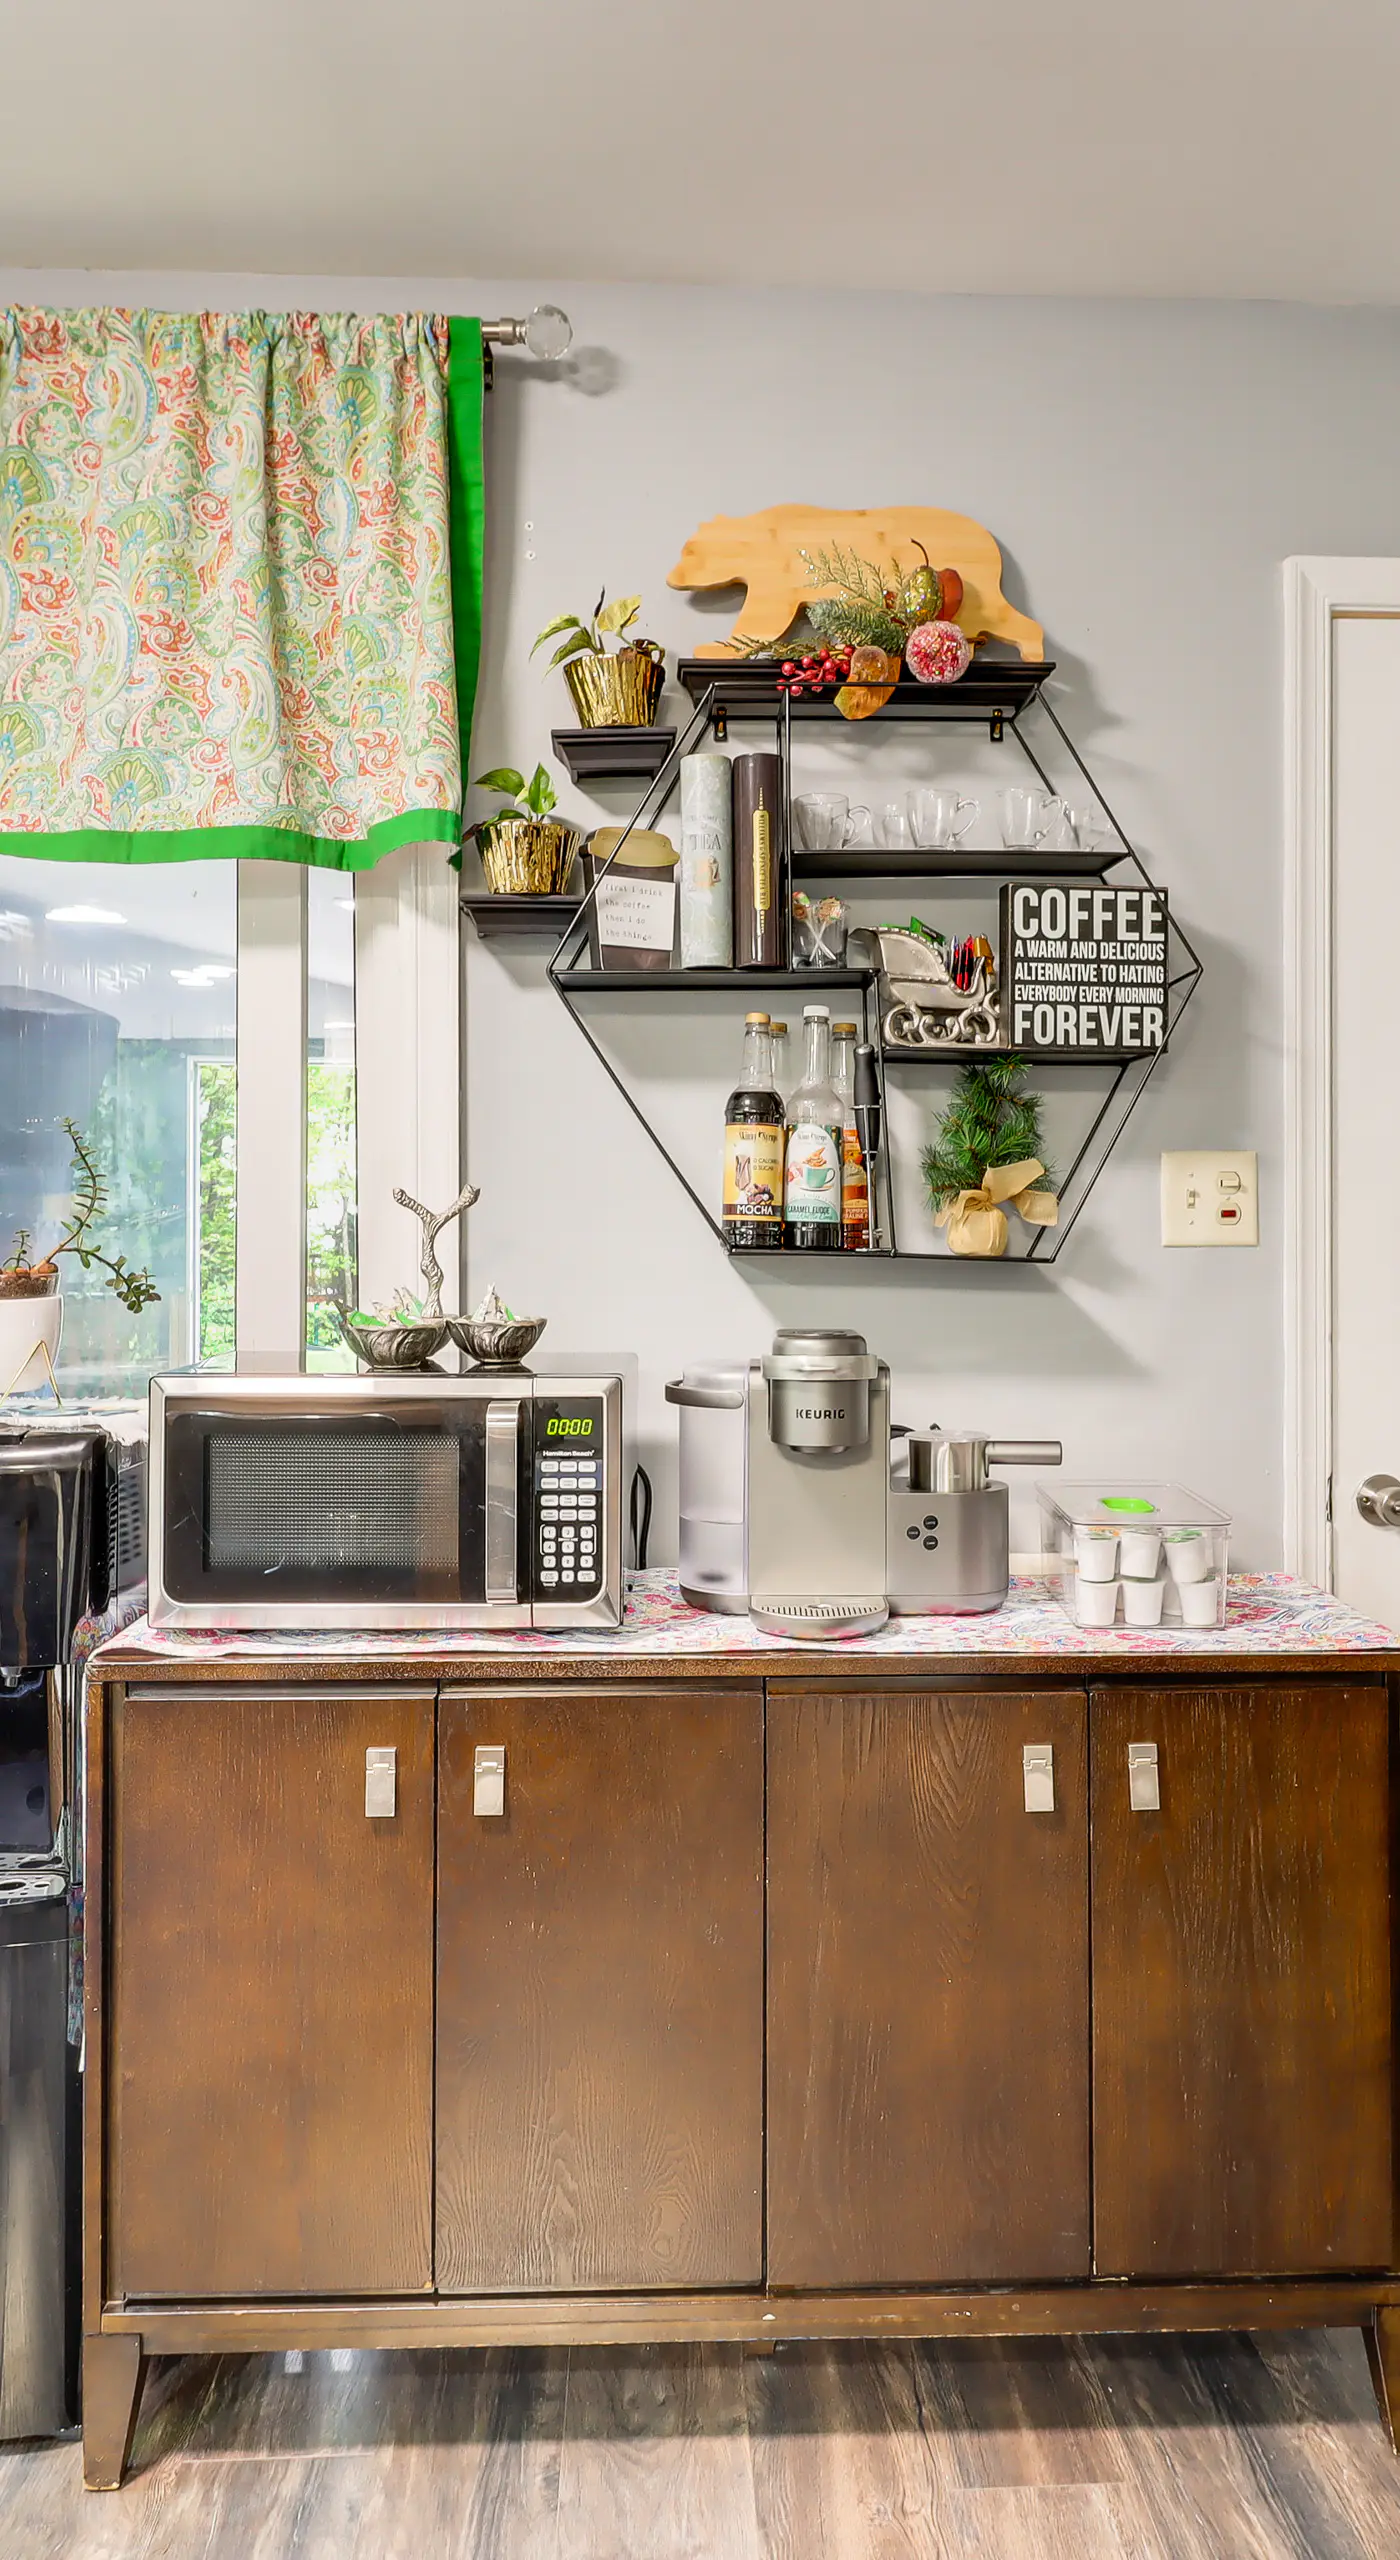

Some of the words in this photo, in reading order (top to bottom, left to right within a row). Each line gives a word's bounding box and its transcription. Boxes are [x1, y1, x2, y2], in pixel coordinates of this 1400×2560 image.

[689, 833, 721, 850] TEA
[640, 888, 663, 897] drink
[605, 898, 619, 907] the
[623, 902, 650, 910] coffee
[605, 914, 624, 922] then
[636, 917, 646, 925] do
[1013, 887, 1165, 941] COFFEE
[605, 929, 620, 938] the
[622, 931, 652, 942] things
[1014, 940, 1025, 958] A
[1026, 940, 1067, 959] WARM
[1070, 941, 1097, 960] AND
[1100, 942, 1165, 961] DELICIOUS
[1014, 962, 1098, 982] ALTERNATIVE
[1101, 964, 1117, 983] TO
[1119, 965, 1164, 984] HATING
[1014, 984, 1078, 1002] EVERYBODY
[1079, 986, 1114, 1003] EVERY
[1115, 987, 1164, 1004] MORNING
[1014, 1003, 1164, 1047] FOREVER
[736, 1204, 773, 1215] MOCHA
[787, 1205, 812, 1214] CARAMEL
[796, 1408, 845, 1419] KEURIG
[547, 1419, 592, 1435] 00:00
